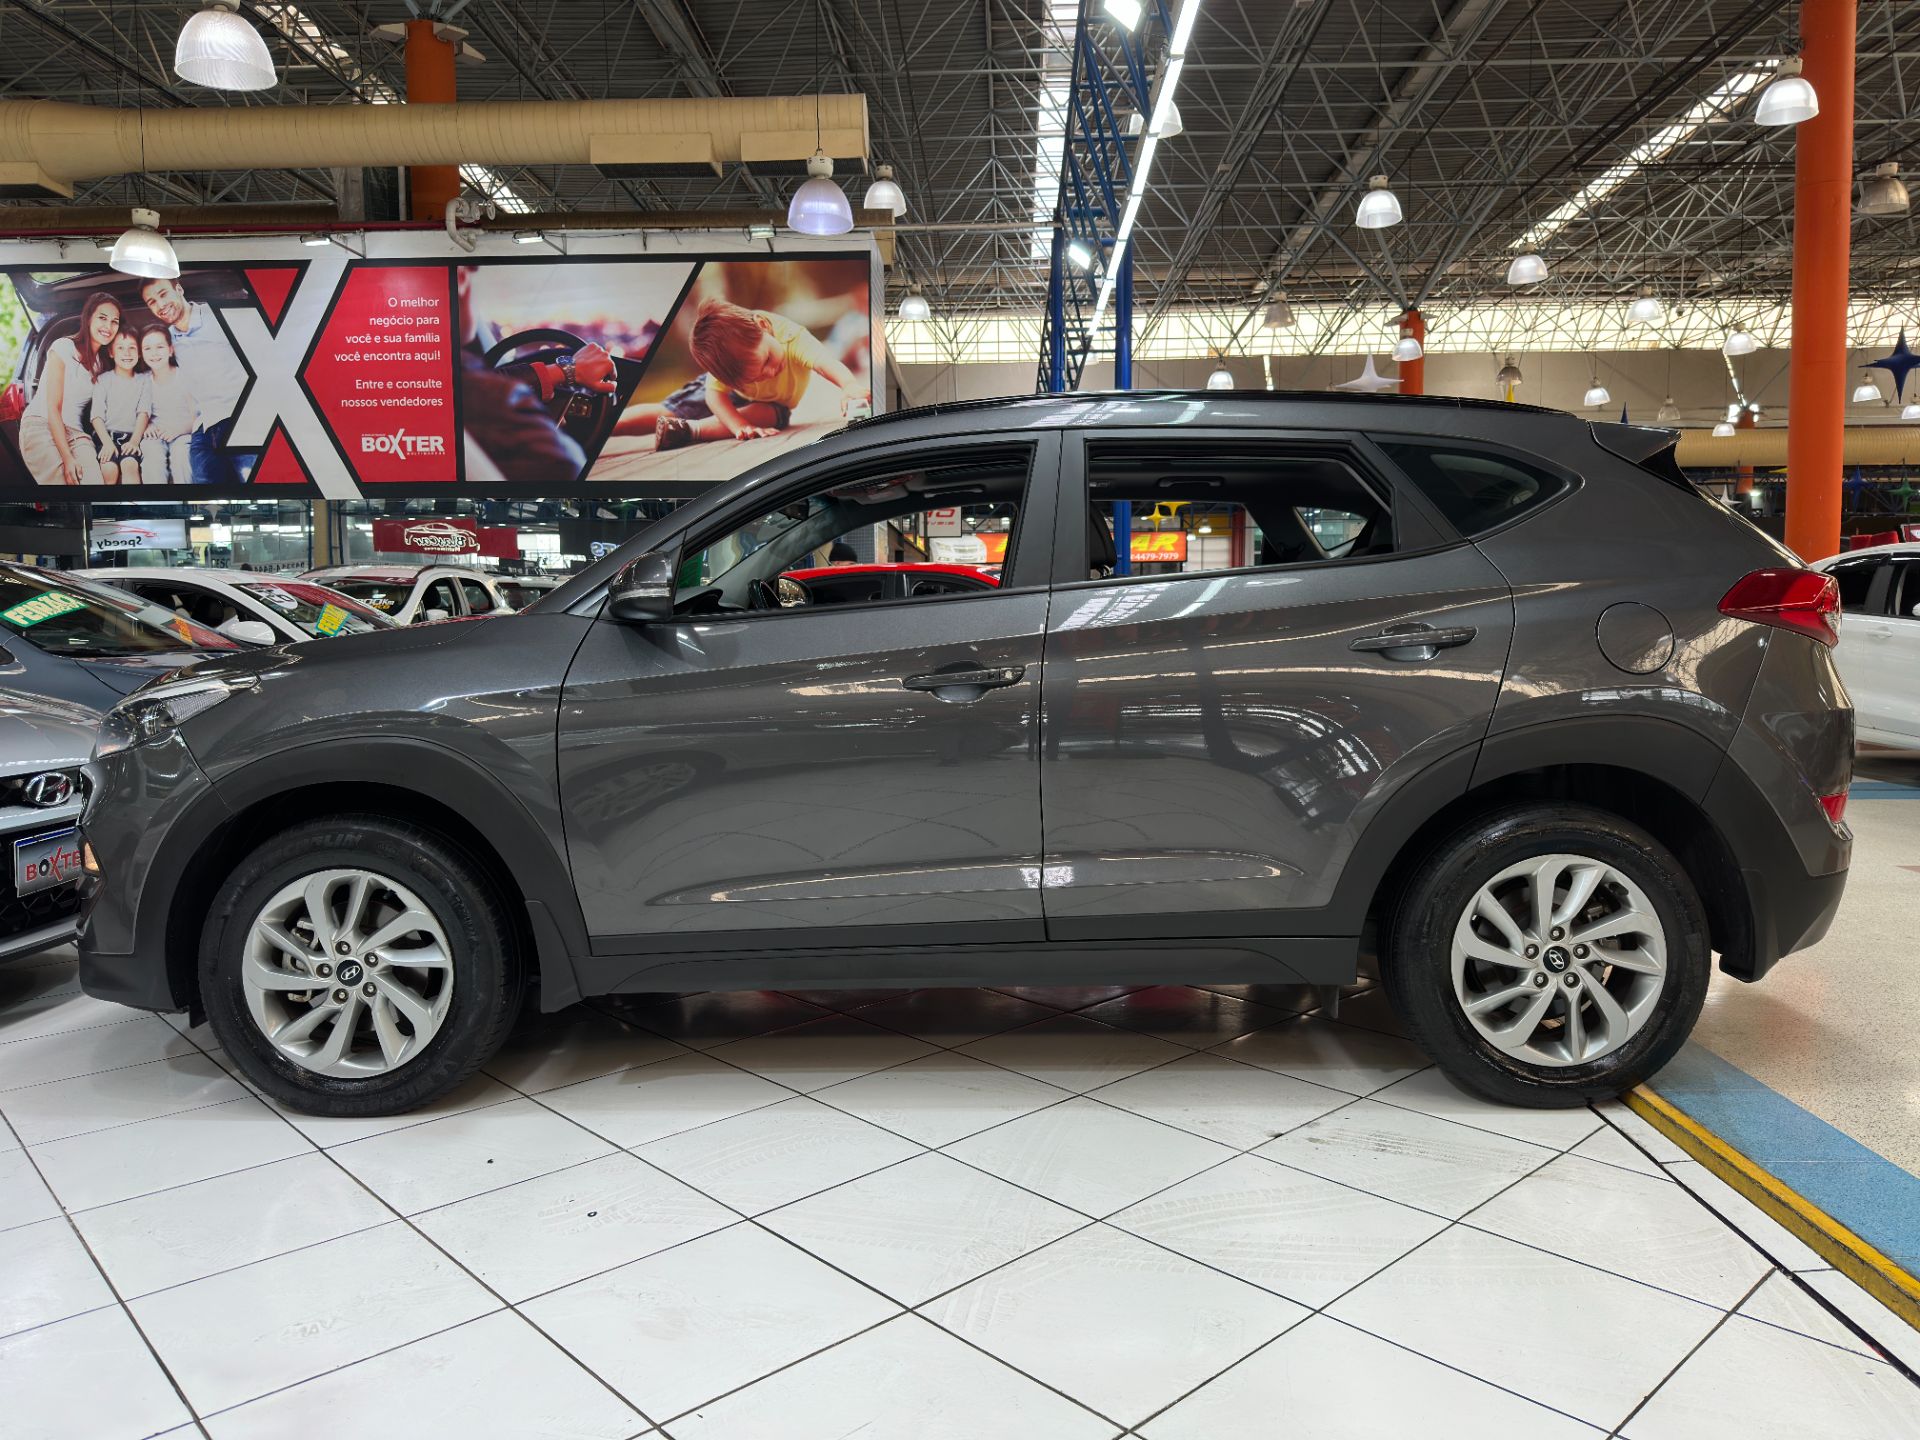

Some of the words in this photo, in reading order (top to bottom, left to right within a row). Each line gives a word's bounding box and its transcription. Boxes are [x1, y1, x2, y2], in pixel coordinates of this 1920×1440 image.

[387, 297, 398, 307] O
[400, 297, 440, 307] melhor
[369, 315, 413, 327] negócio
[416, 316, 440, 327] para
[345, 333, 372, 343] você
[374, 335, 381, 343] e
[383, 334, 402, 343] sua
[404, 332, 440, 343] família
[334, 351, 360, 361] você
[363, 351, 412, 361] encontra
[414, 350, 441, 363] aqui!
[355, 379, 384, 389] Entre
[386, 381, 393, 389] e
[395, 378, 443, 389] consulte
[341, 399, 378, 407] nossos
[380, 396, 443, 407] vendedores
[361, 428, 445, 460] BOXTER
[26, 846, 81, 881] BOXTE
